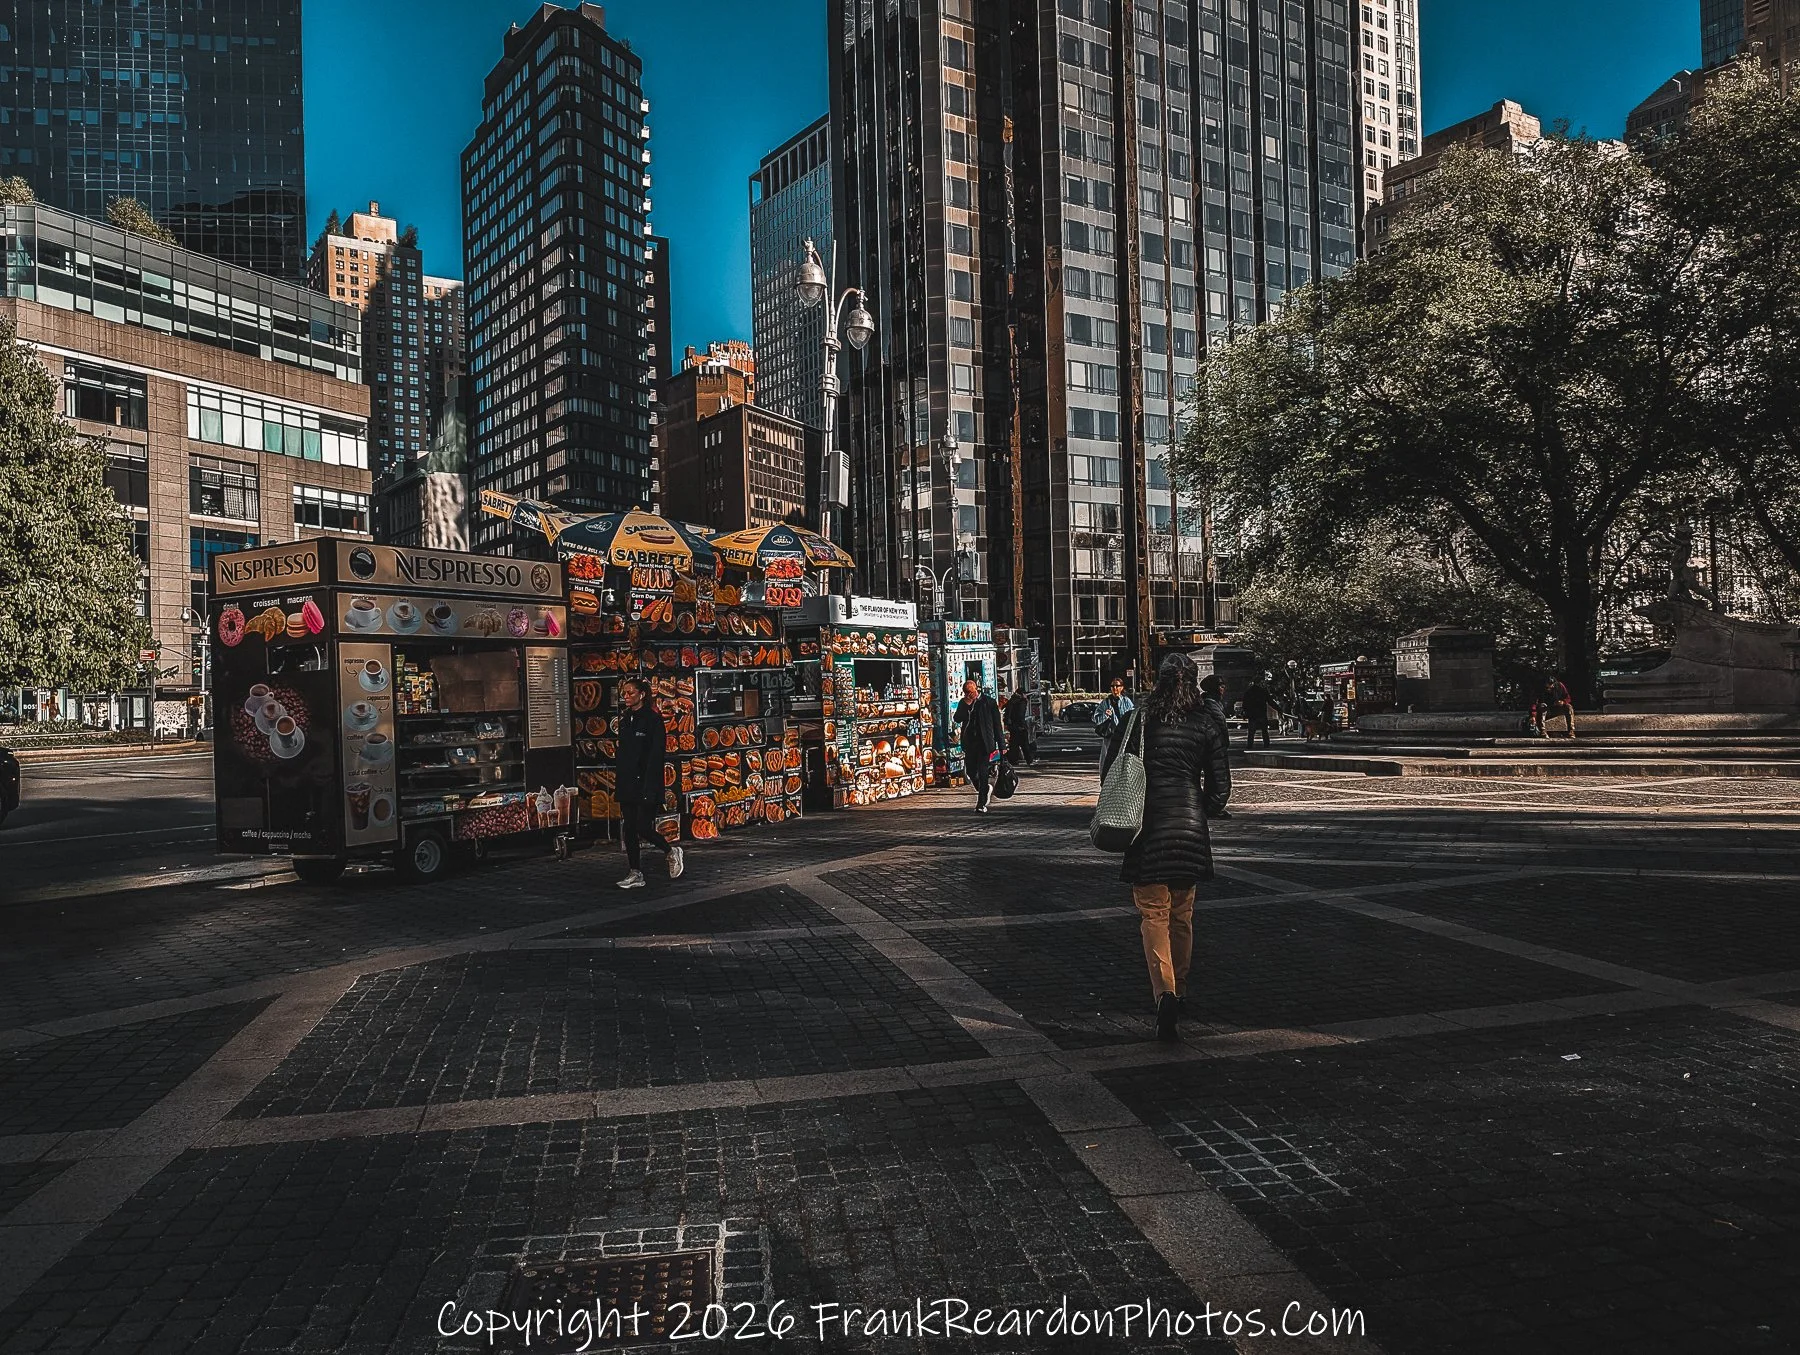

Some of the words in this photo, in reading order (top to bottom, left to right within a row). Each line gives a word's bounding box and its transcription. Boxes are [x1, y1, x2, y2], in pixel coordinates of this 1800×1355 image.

[624, 525, 671, 535] SABRETT
[616, 548, 688, 567] SABRETT
[722, 548, 753, 562] BRETT
[216, 552, 317, 586] NESPRESSO
[390, 548, 521, 587] NESPRESSO
[584, 586, 595, 594] Dog
[253, 597, 281, 608] croissant
[286, 594, 313, 604] macaron
[223, 602, 239, 611] donut
[242, 829, 258, 838] coffee
[261, 830, 290, 840] cappuccino
[293, 831, 312, 839] mocha
